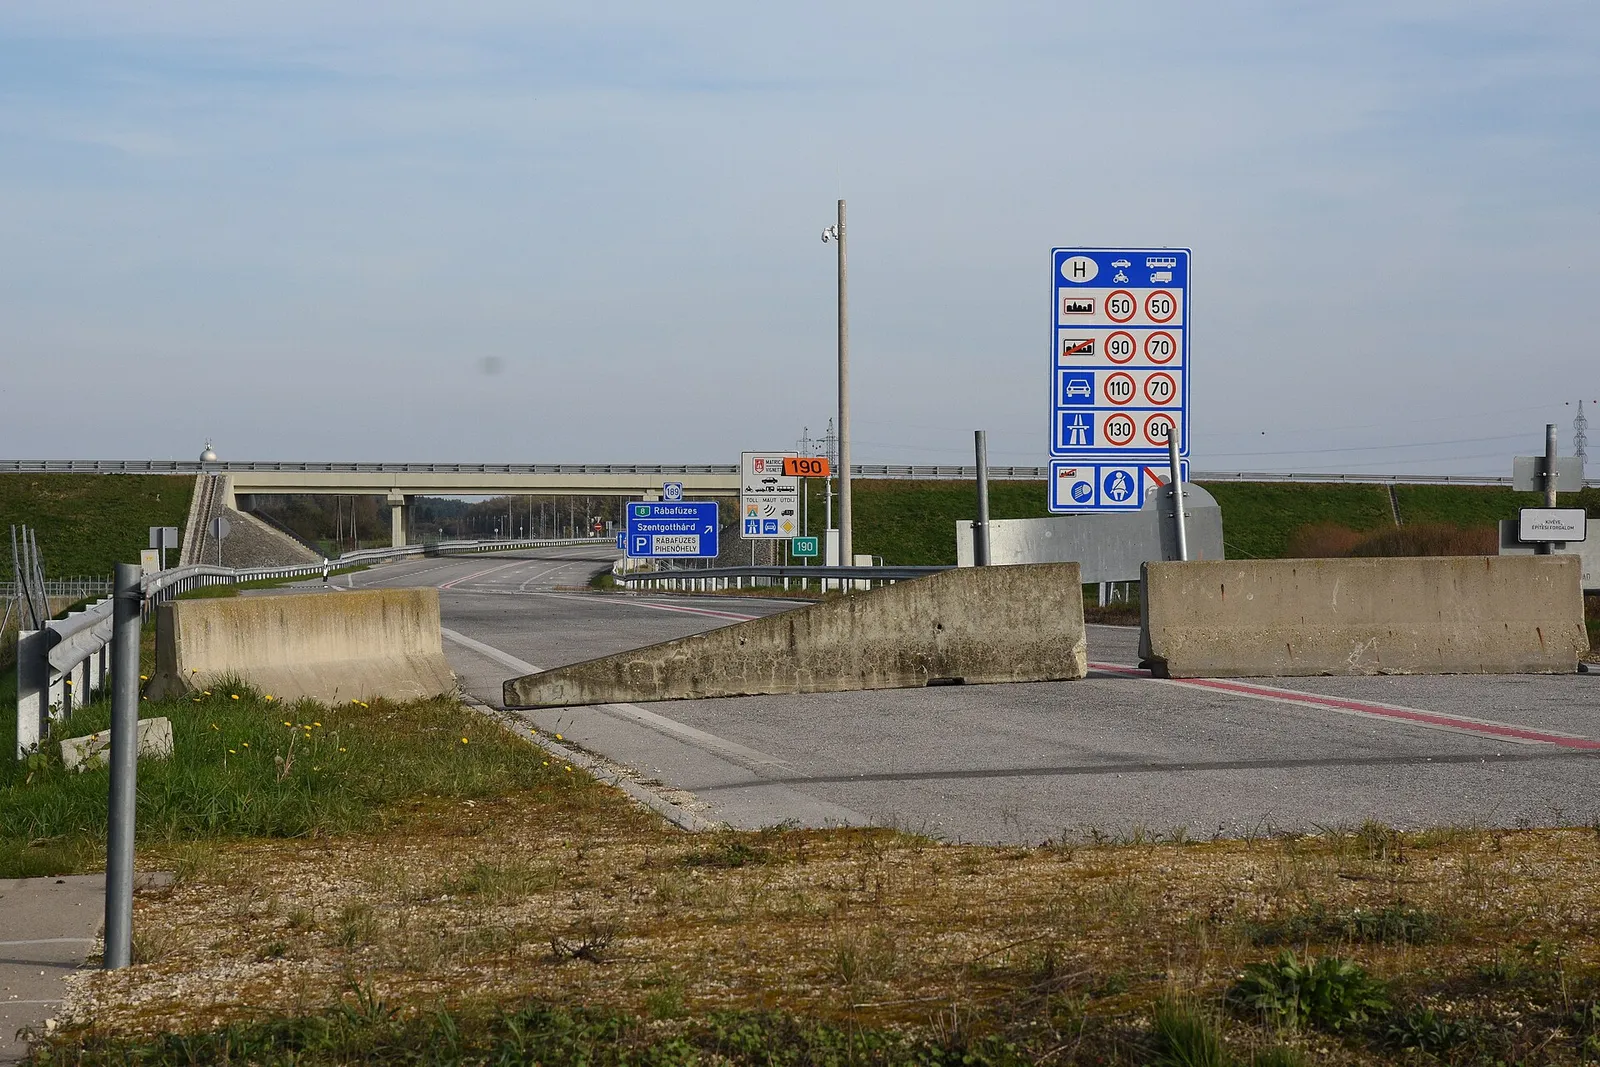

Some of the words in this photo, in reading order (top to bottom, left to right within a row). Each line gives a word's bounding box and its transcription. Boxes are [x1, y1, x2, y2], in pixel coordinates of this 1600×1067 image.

[1073, 261, 1086, 278] H
[1111, 299, 1130, 314] 50
[1151, 299, 1170, 314] 50
[1111, 340, 1129, 355] 90
[1151, 340, 1169, 355] 70
[1110, 381, 1130, 396] 110
[1151, 381, 1169, 396] 70
[1109, 422, 1131, 437] 130
[1151, 422, 1169, 437] 80
[791, 460, 822, 474] 190
[667, 488, 679, 496] 189
[640, 507, 646, 515] 8
[654, 506, 698, 515] Rábafüzes
[637, 523, 696, 532] Szentgotthárd
[636, 537, 647, 552] P
[655, 535, 696, 544] RÁBAFÜZES
[796, 541, 813, 552] 190
